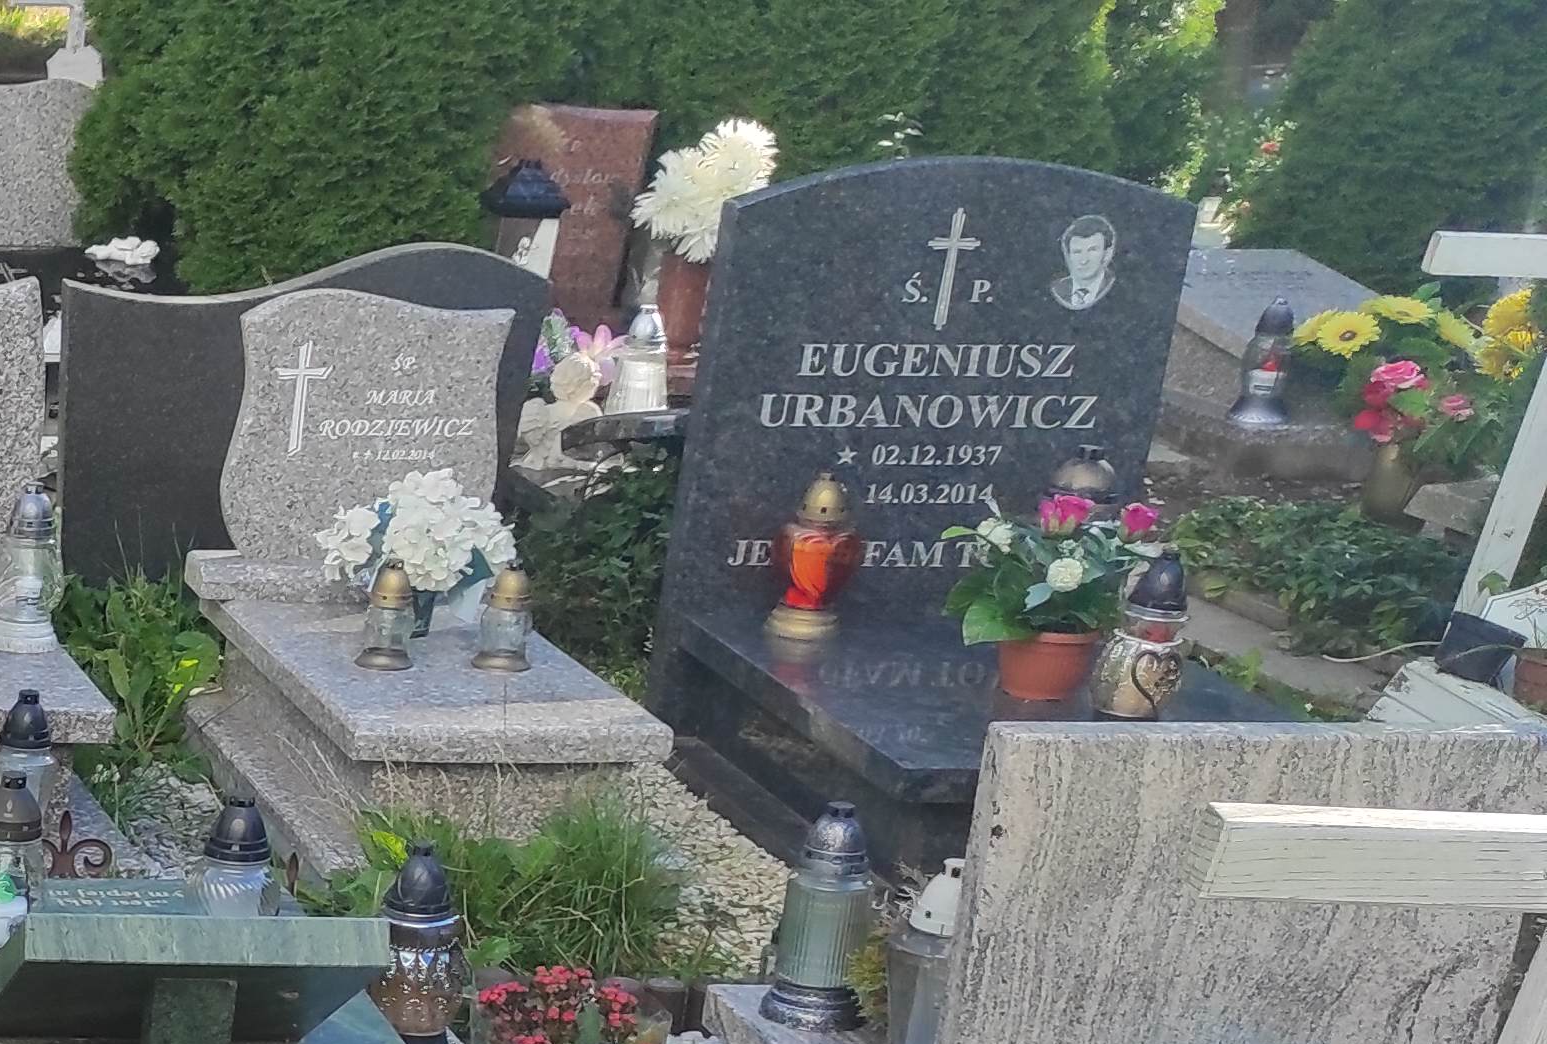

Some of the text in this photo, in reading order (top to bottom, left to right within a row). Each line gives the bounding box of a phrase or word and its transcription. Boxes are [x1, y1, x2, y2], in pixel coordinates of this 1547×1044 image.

[796, 343, 1076, 378] EUGENIUSZ
[365, 389, 436, 406] MARIA
[758, 394, 1099, 430] URBANOWICZ
[319, 416, 477, 439] RODZIEWICZ
[871, 445, 1003, 467] 02.12.1937
[865, 484, 994, 505] 14.03.2014
